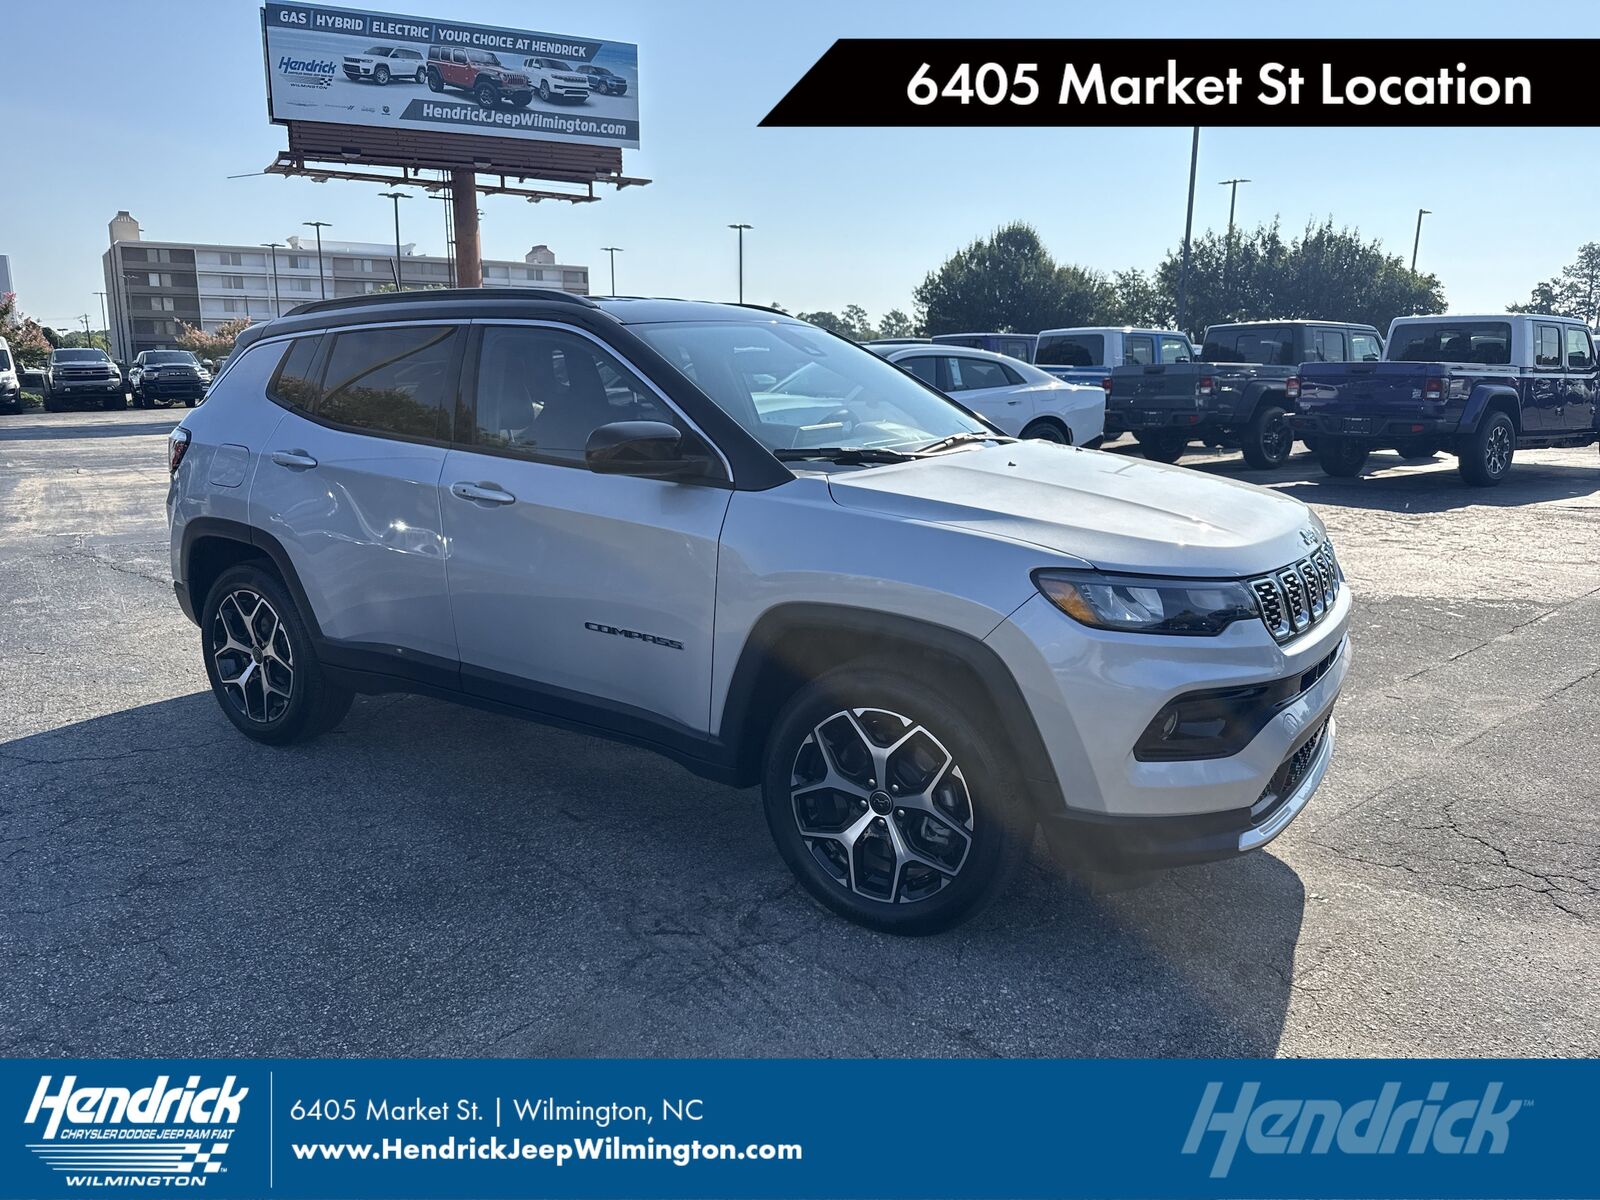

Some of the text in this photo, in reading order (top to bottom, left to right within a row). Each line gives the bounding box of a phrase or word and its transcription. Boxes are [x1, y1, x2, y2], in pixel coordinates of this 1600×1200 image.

[279, 10, 587, 58] GAS HYBRID ELECTRIC YOUR CHOICE AT HENDRICK
[278, 56, 337, 74] Hendrick
[422, 103, 627, 136] HendrickJeepWilmington.com
[584, 621, 684, 650] COMPASS
